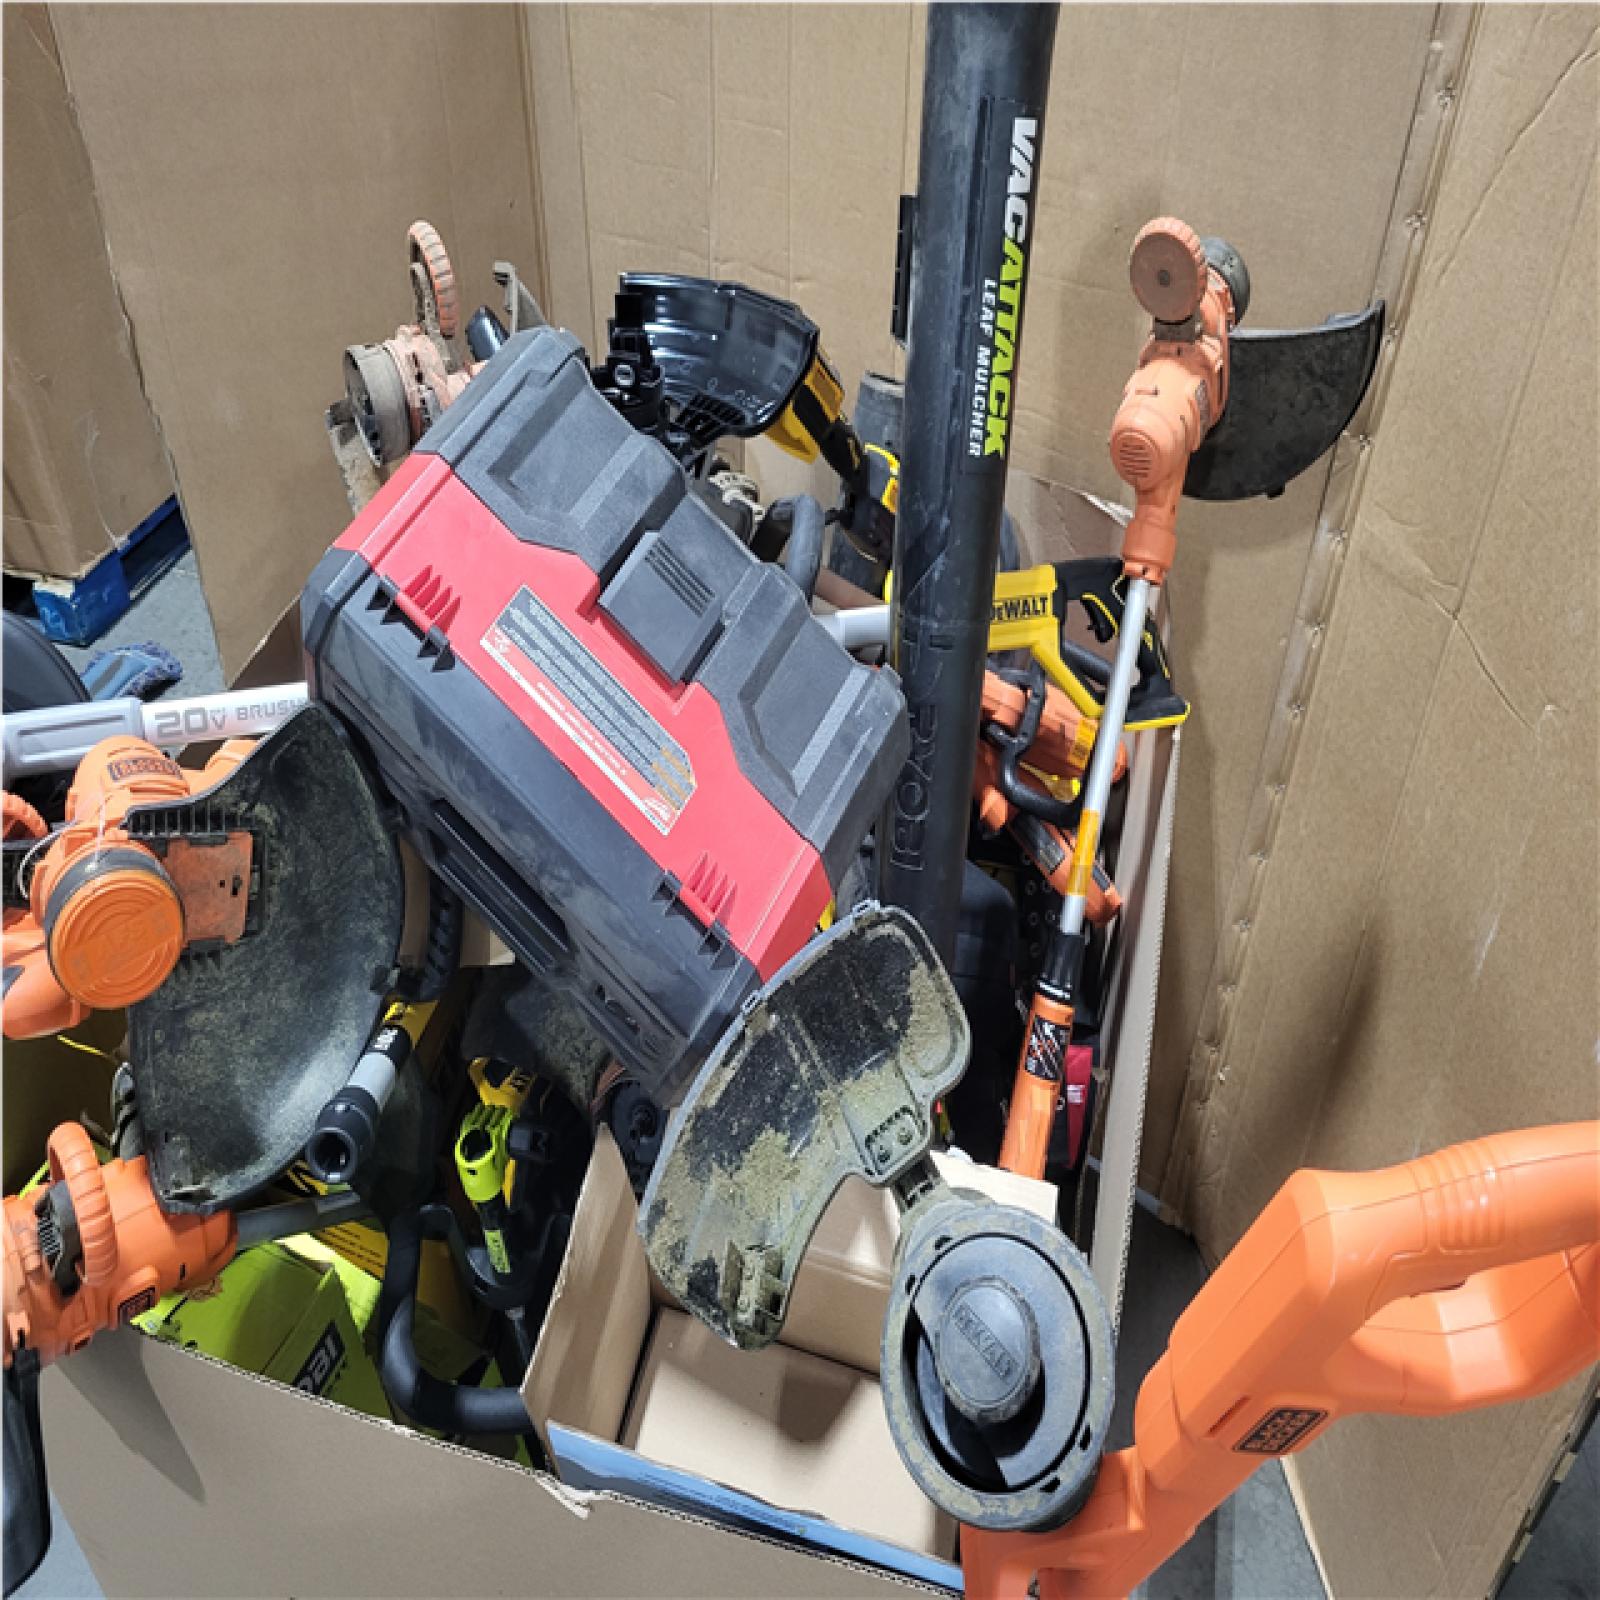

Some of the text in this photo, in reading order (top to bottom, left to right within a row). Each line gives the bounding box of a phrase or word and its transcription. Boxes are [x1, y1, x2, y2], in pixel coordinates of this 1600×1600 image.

[969, 278, 997, 458] LEAF MULCHER
[983, 117, 1038, 458] VACATTACK
